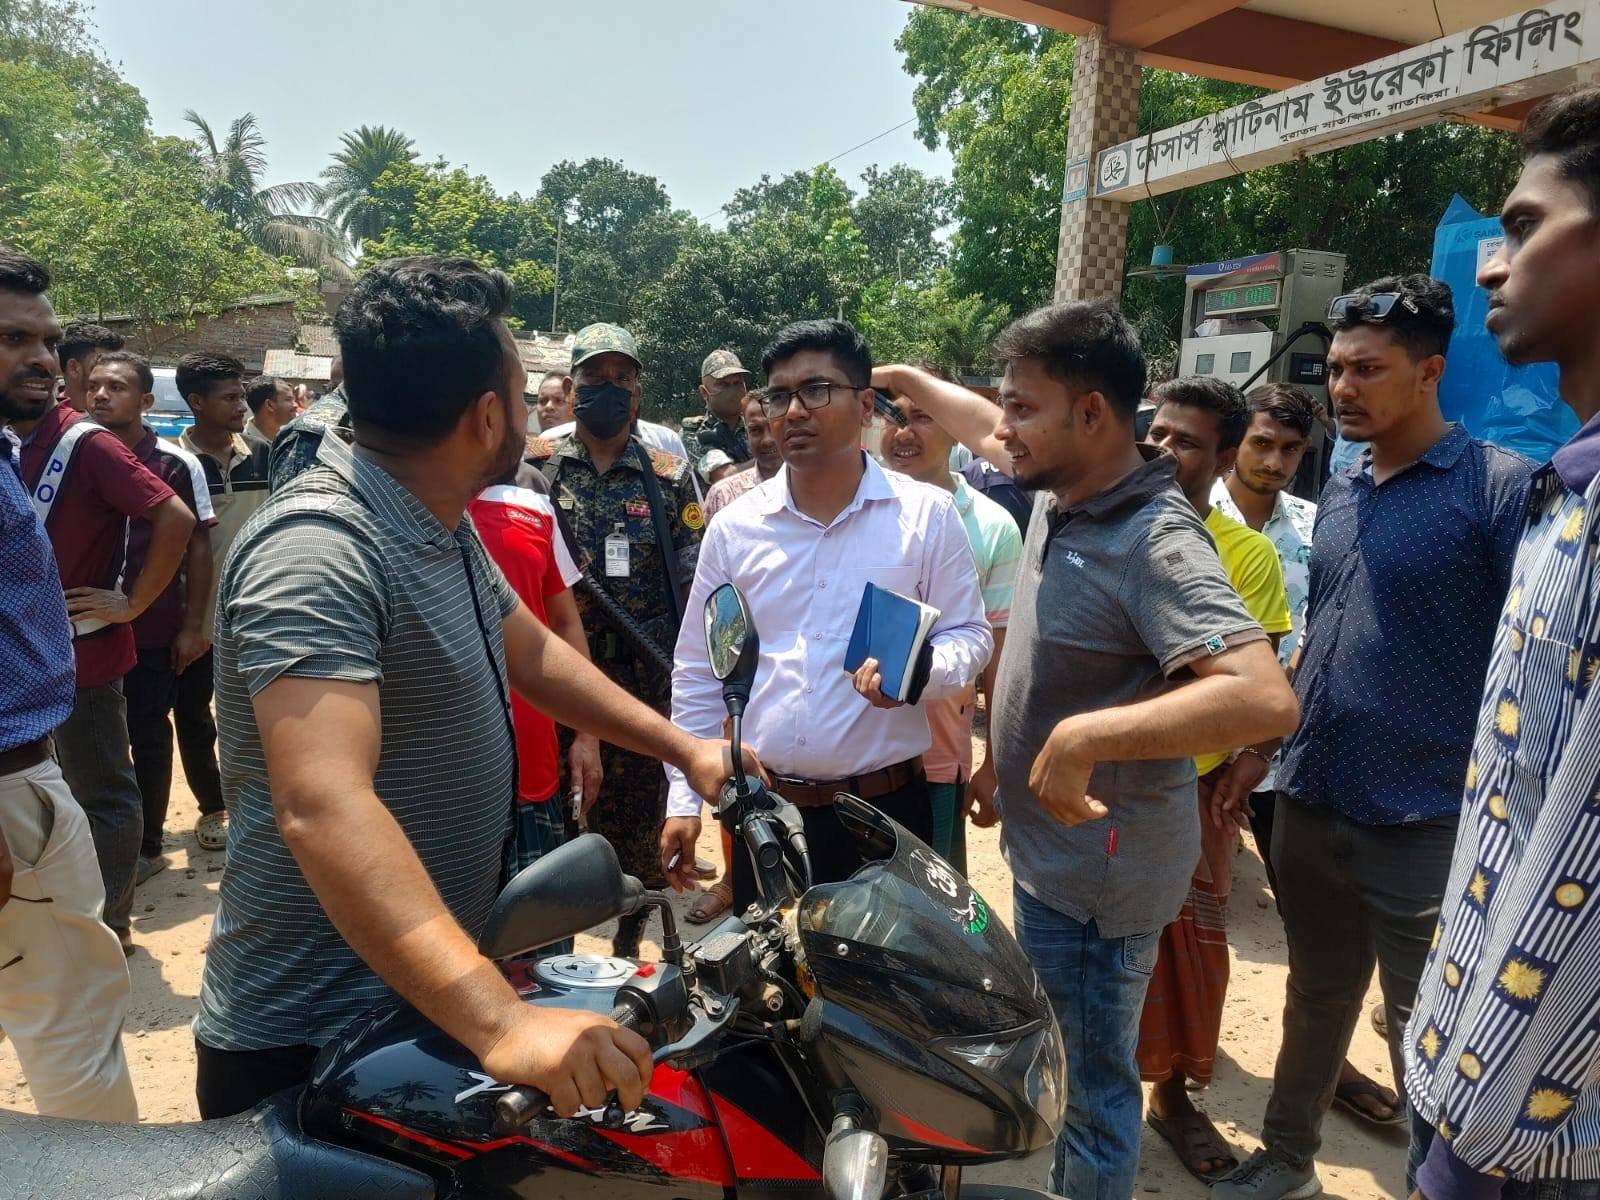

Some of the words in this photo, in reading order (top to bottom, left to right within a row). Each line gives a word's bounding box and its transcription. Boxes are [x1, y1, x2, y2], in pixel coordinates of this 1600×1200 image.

[1135, 116, 1209, 171] মেসার্স
[1321, 45, 1454, 116] ইউরেকা
[1463, 8, 1583, 75] ফিলিং
